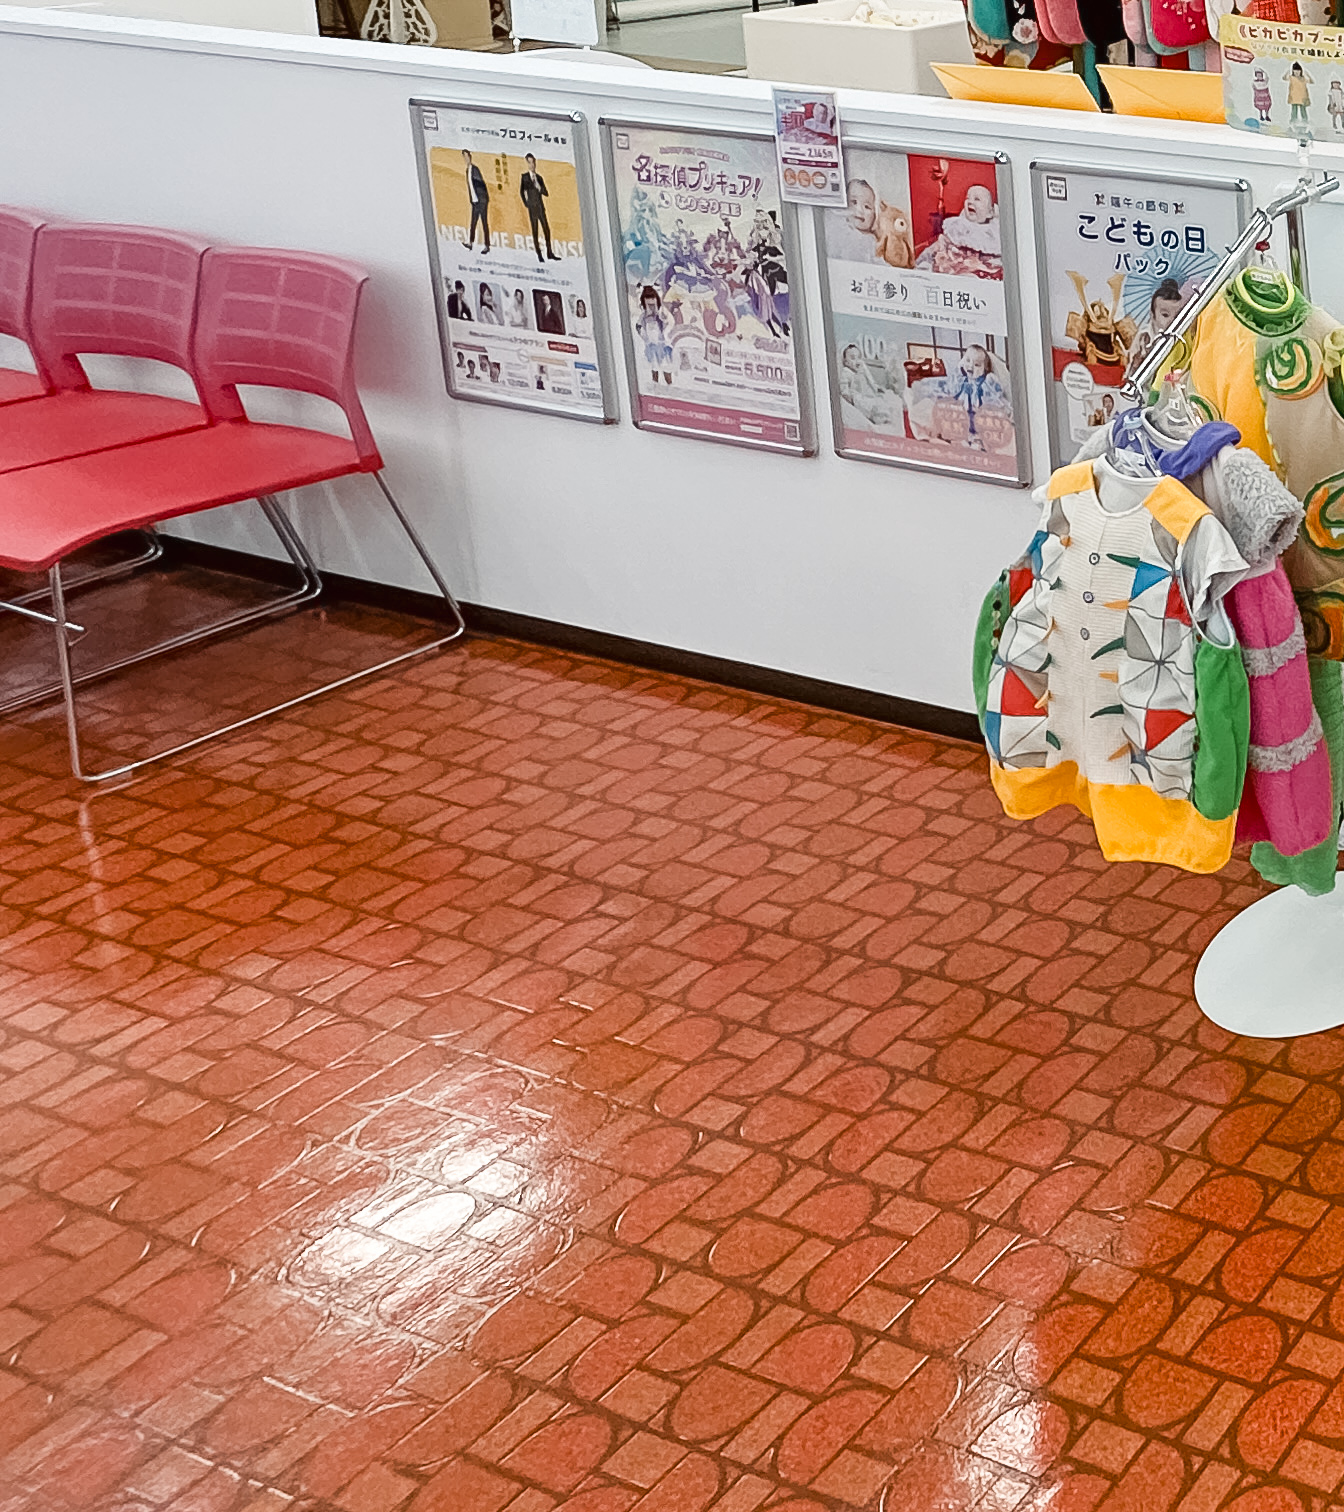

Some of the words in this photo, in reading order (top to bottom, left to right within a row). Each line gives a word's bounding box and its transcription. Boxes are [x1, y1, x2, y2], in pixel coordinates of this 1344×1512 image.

[514, 234, 584, 258] BENS!
[1078, 214, 1205, 254] こどもの日
[1115, 253, 1171, 276] パック
[850, 276, 908, 302] お宮参り
[923, 284, 987, 310] 百日祝い
